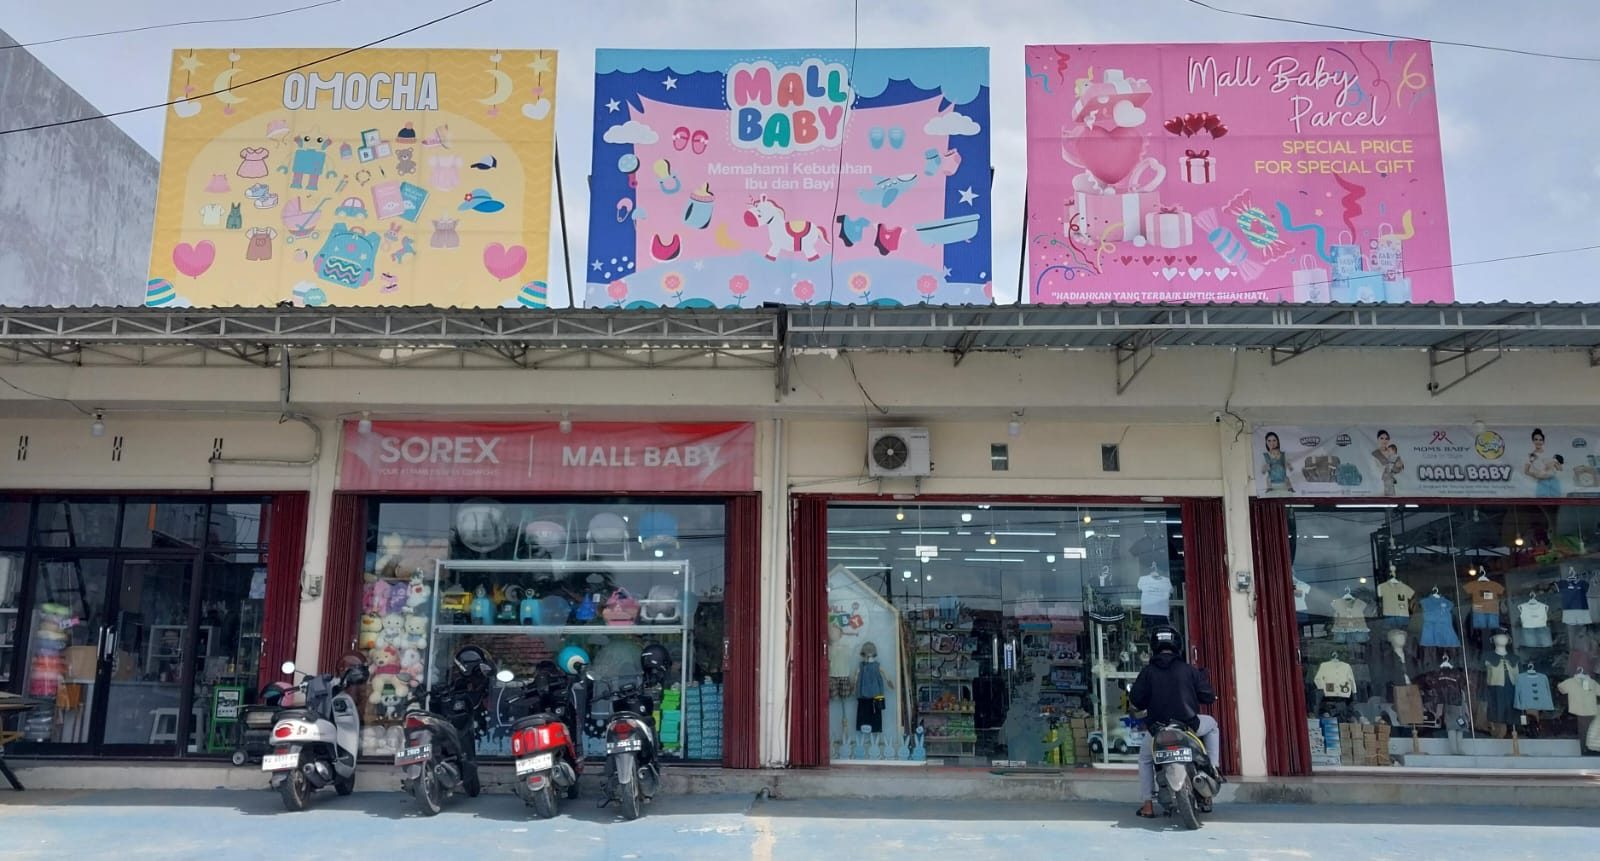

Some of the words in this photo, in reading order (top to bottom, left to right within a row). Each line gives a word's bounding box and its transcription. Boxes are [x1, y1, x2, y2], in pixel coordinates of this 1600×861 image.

[282, 72, 439, 111] OMOCHA
[733, 64, 848, 108] MALL
[1186, 56, 1260, 96] Mall
[1266, 56, 1358, 107] Baby
[1289, 94, 1387, 133] Parcel
[738, 105, 844, 148] BABY
[1282, 141, 1357, 155] SPECIAL
[1361, 140, 1413, 154] PRICE
[707, 162, 789, 175] Memahami
[793, 162, 872, 175] Kebutuhan
[1255, 161, 1293, 174] FOR
[1297, 160, 1372, 174] SPECIAL
[1375, 159, 1415, 173] GIFT
[745, 177, 769, 190] Ibu
[771, 177, 799, 190] dan
[803, 177, 835, 192] Bayi
[1113, 291, 1140, 301] YANG
[1141, 291, 1181, 301] TERBAIK
[379, 436, 501, 465] SOREX
[562, 447, 636, 467] MALL
[645, 446, 721, 468] BABY
[1418, 465, 1464, 481] MALL
[1466, 465, 1513, 481] BABY
